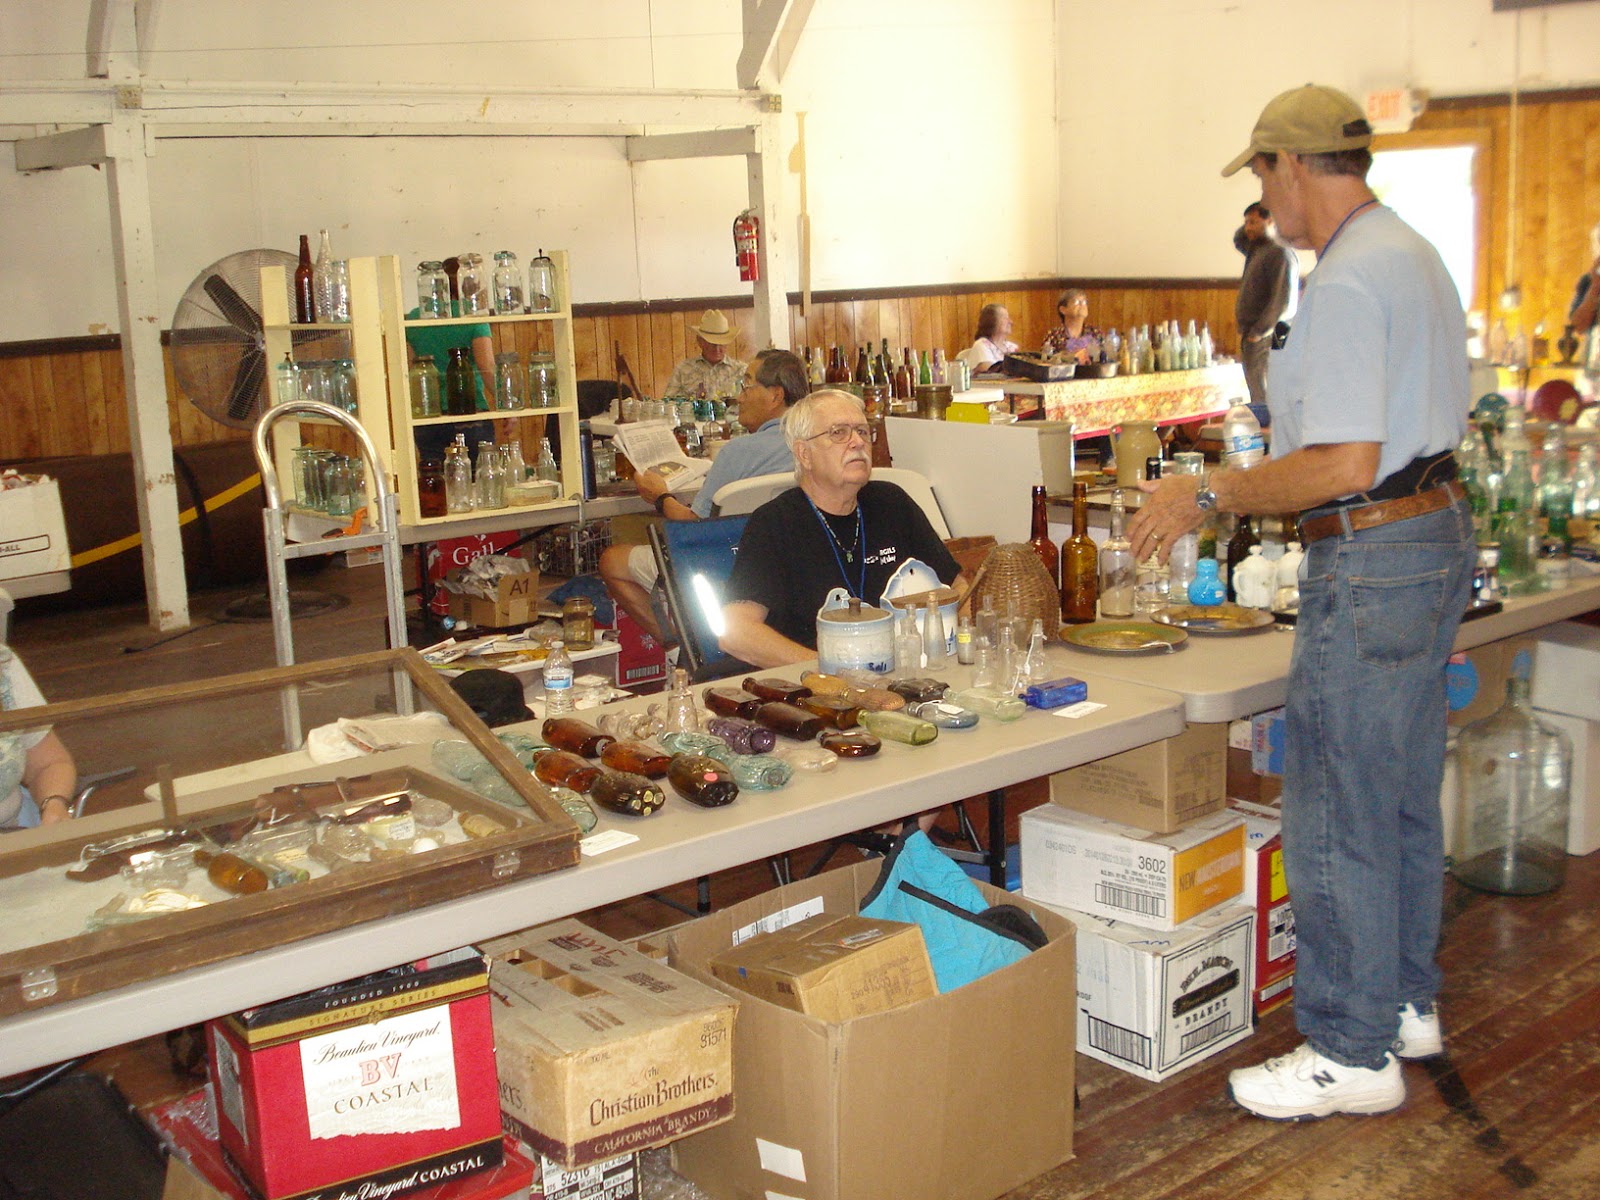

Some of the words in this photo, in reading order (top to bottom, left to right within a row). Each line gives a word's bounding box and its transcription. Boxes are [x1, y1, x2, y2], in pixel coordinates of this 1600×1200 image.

[509, 578, 530, 596] A1
[1138, 856, 1166, 874] 3602
[1179, 870, 1195, 892] NEW
[309, 1003, 384, 1026] SIGNATURE
[393, 990, 437, 1006] SERIES
[325, 990, 383, 1008] FOUNDED
[392, 981, 420, 992] 1900
[1185, 997, 1228, 1026] BRANDY
[313, 1039, 379, 1065] Beaulieu
[334, 1077, 433, 1114] COASTAL
[590, 1092, 656, 1126] Christian
[594, 1124, 663, 1154] CALIFORNIA
[667, 1107, 711, 1132] BRANDY
[419, 1155, 485, 1183] COASTAL
